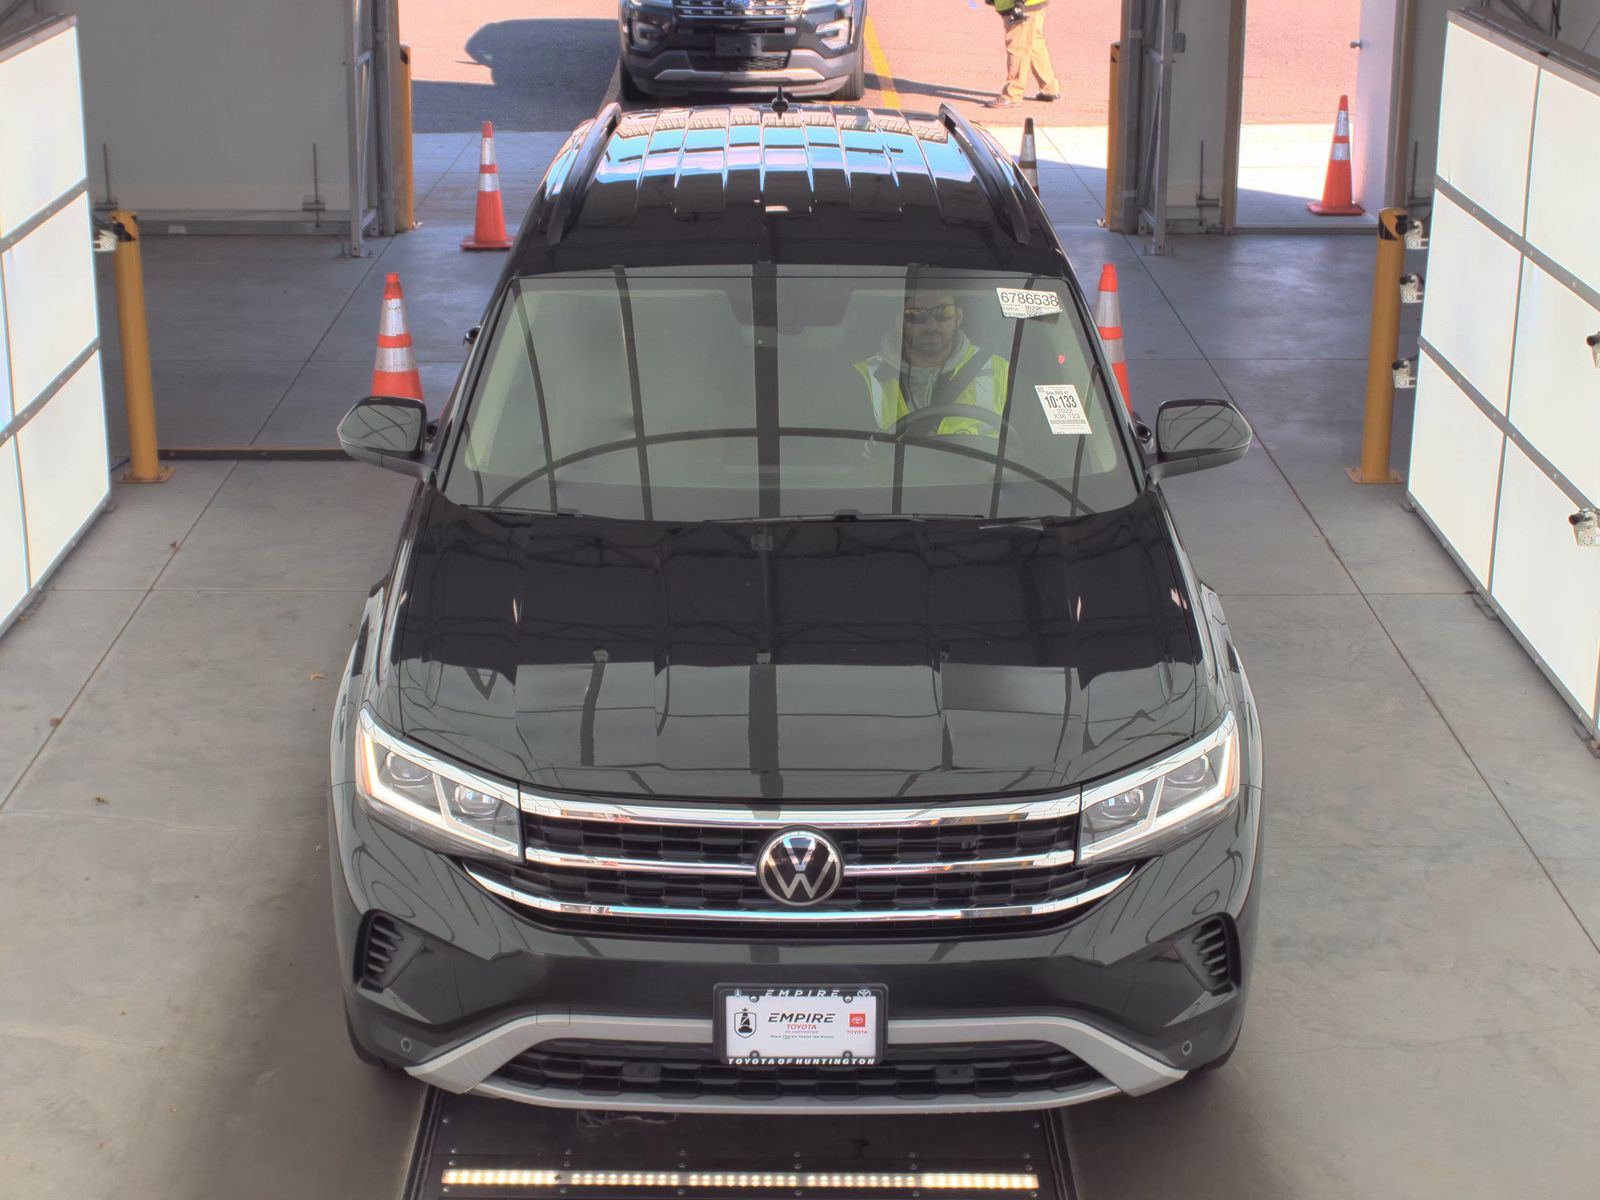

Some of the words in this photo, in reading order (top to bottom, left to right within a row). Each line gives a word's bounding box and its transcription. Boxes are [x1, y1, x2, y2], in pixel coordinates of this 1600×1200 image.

[1000, 291, 1059, 307] 6786538
[1044, 395, 1077, 409] 10:133
[765, 989, 840, 998] EMPIRE
[768, 1012, 836, 1023] EMPIRE
